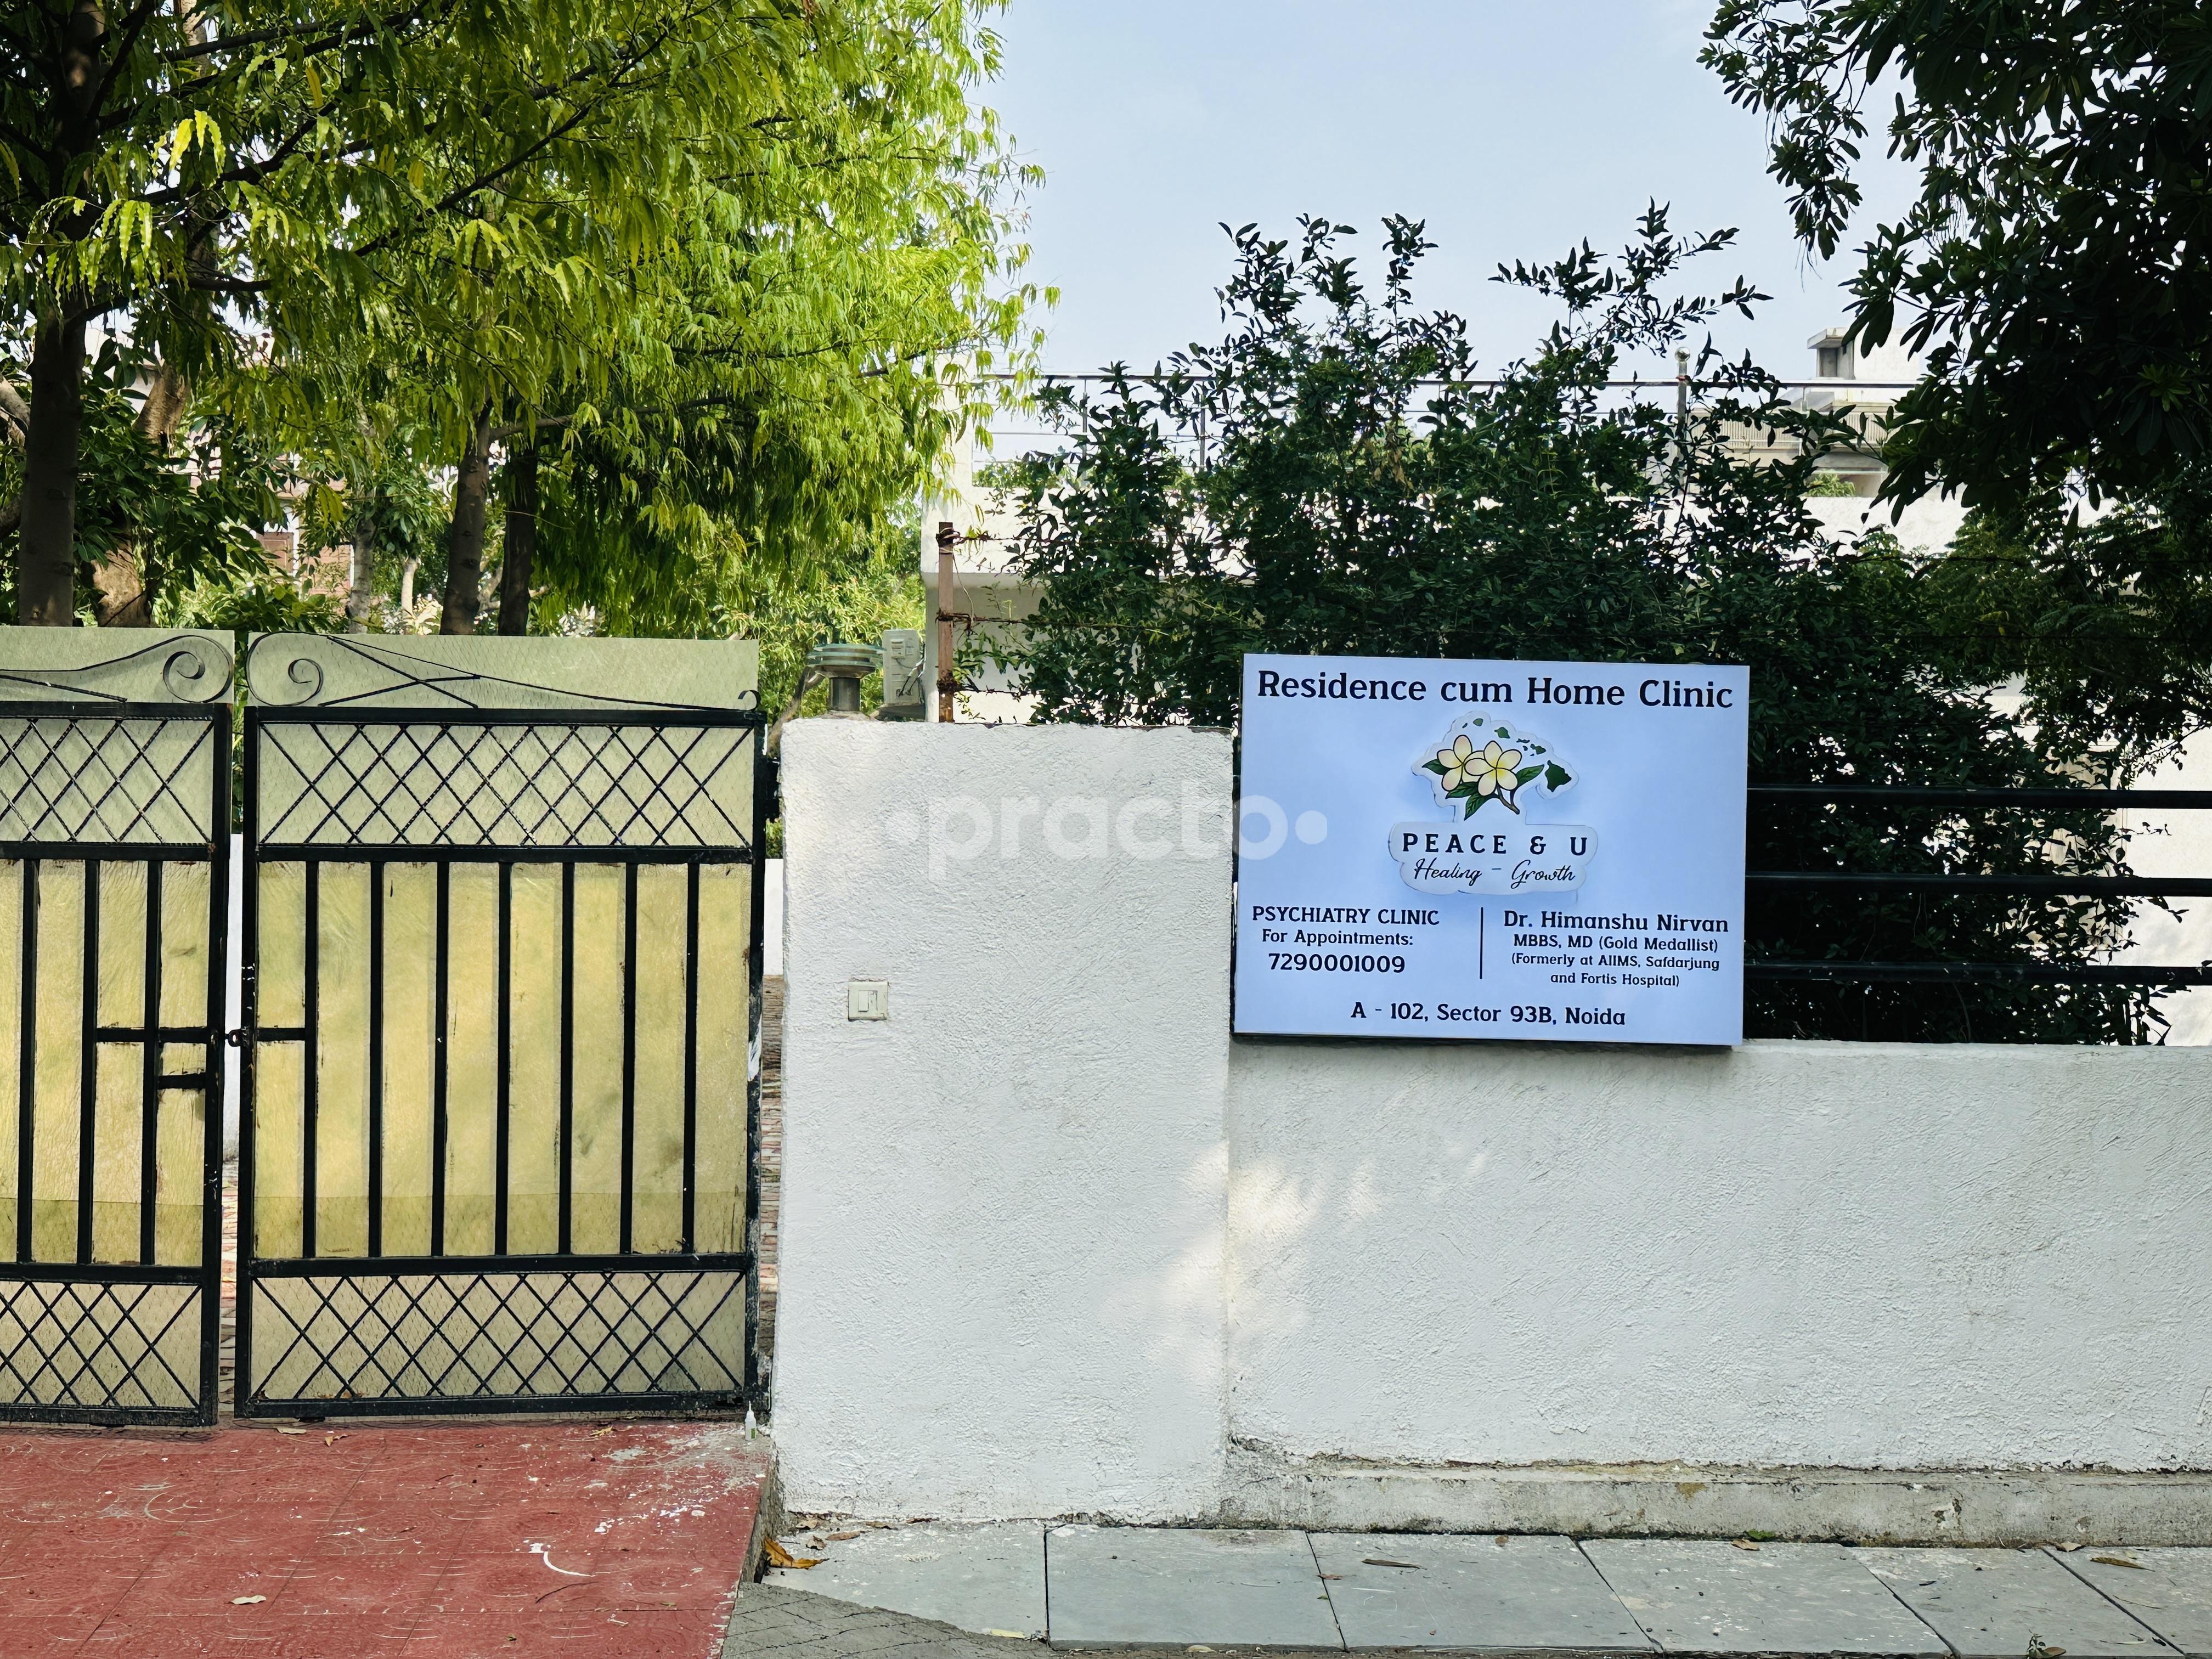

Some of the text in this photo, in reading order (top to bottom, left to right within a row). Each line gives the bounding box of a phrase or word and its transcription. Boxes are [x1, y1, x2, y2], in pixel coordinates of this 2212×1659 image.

[1257, 670, 1733, 708] Residence cum Home Clinic
[1402, 833, 1588, 856] PEACE & U
[1414, 857, 1482, 887] Healing
[1510, 859, 1576, 888] Growth
[1252, 906, 1440, 926] PSYCHIATRY CLINIC
[1504, 910, 1729, 933] Dr. Himanshu Nirvan
[1262, 928, 1413, 947] For Appointments:
[1514, 934, 1718, 953] MBBS, MD (Gold Medallist)
[1268, 953, 1405, 973] 7290001009
[1511, 952, 1719, 972] (Formerly at AIIMS, Safdarjung
[1550, 972, 1679, 988] and Fortis Hospital)
[1350, 1001, 1367, 1018] A
[1391, 1002, 1429, 1022] 102,
[1437, 1003, 1502, 1022] Sector
[1510, 1005, 1556, 1025] 93B,
[1565, 1007, 1626, 1025] Noida
